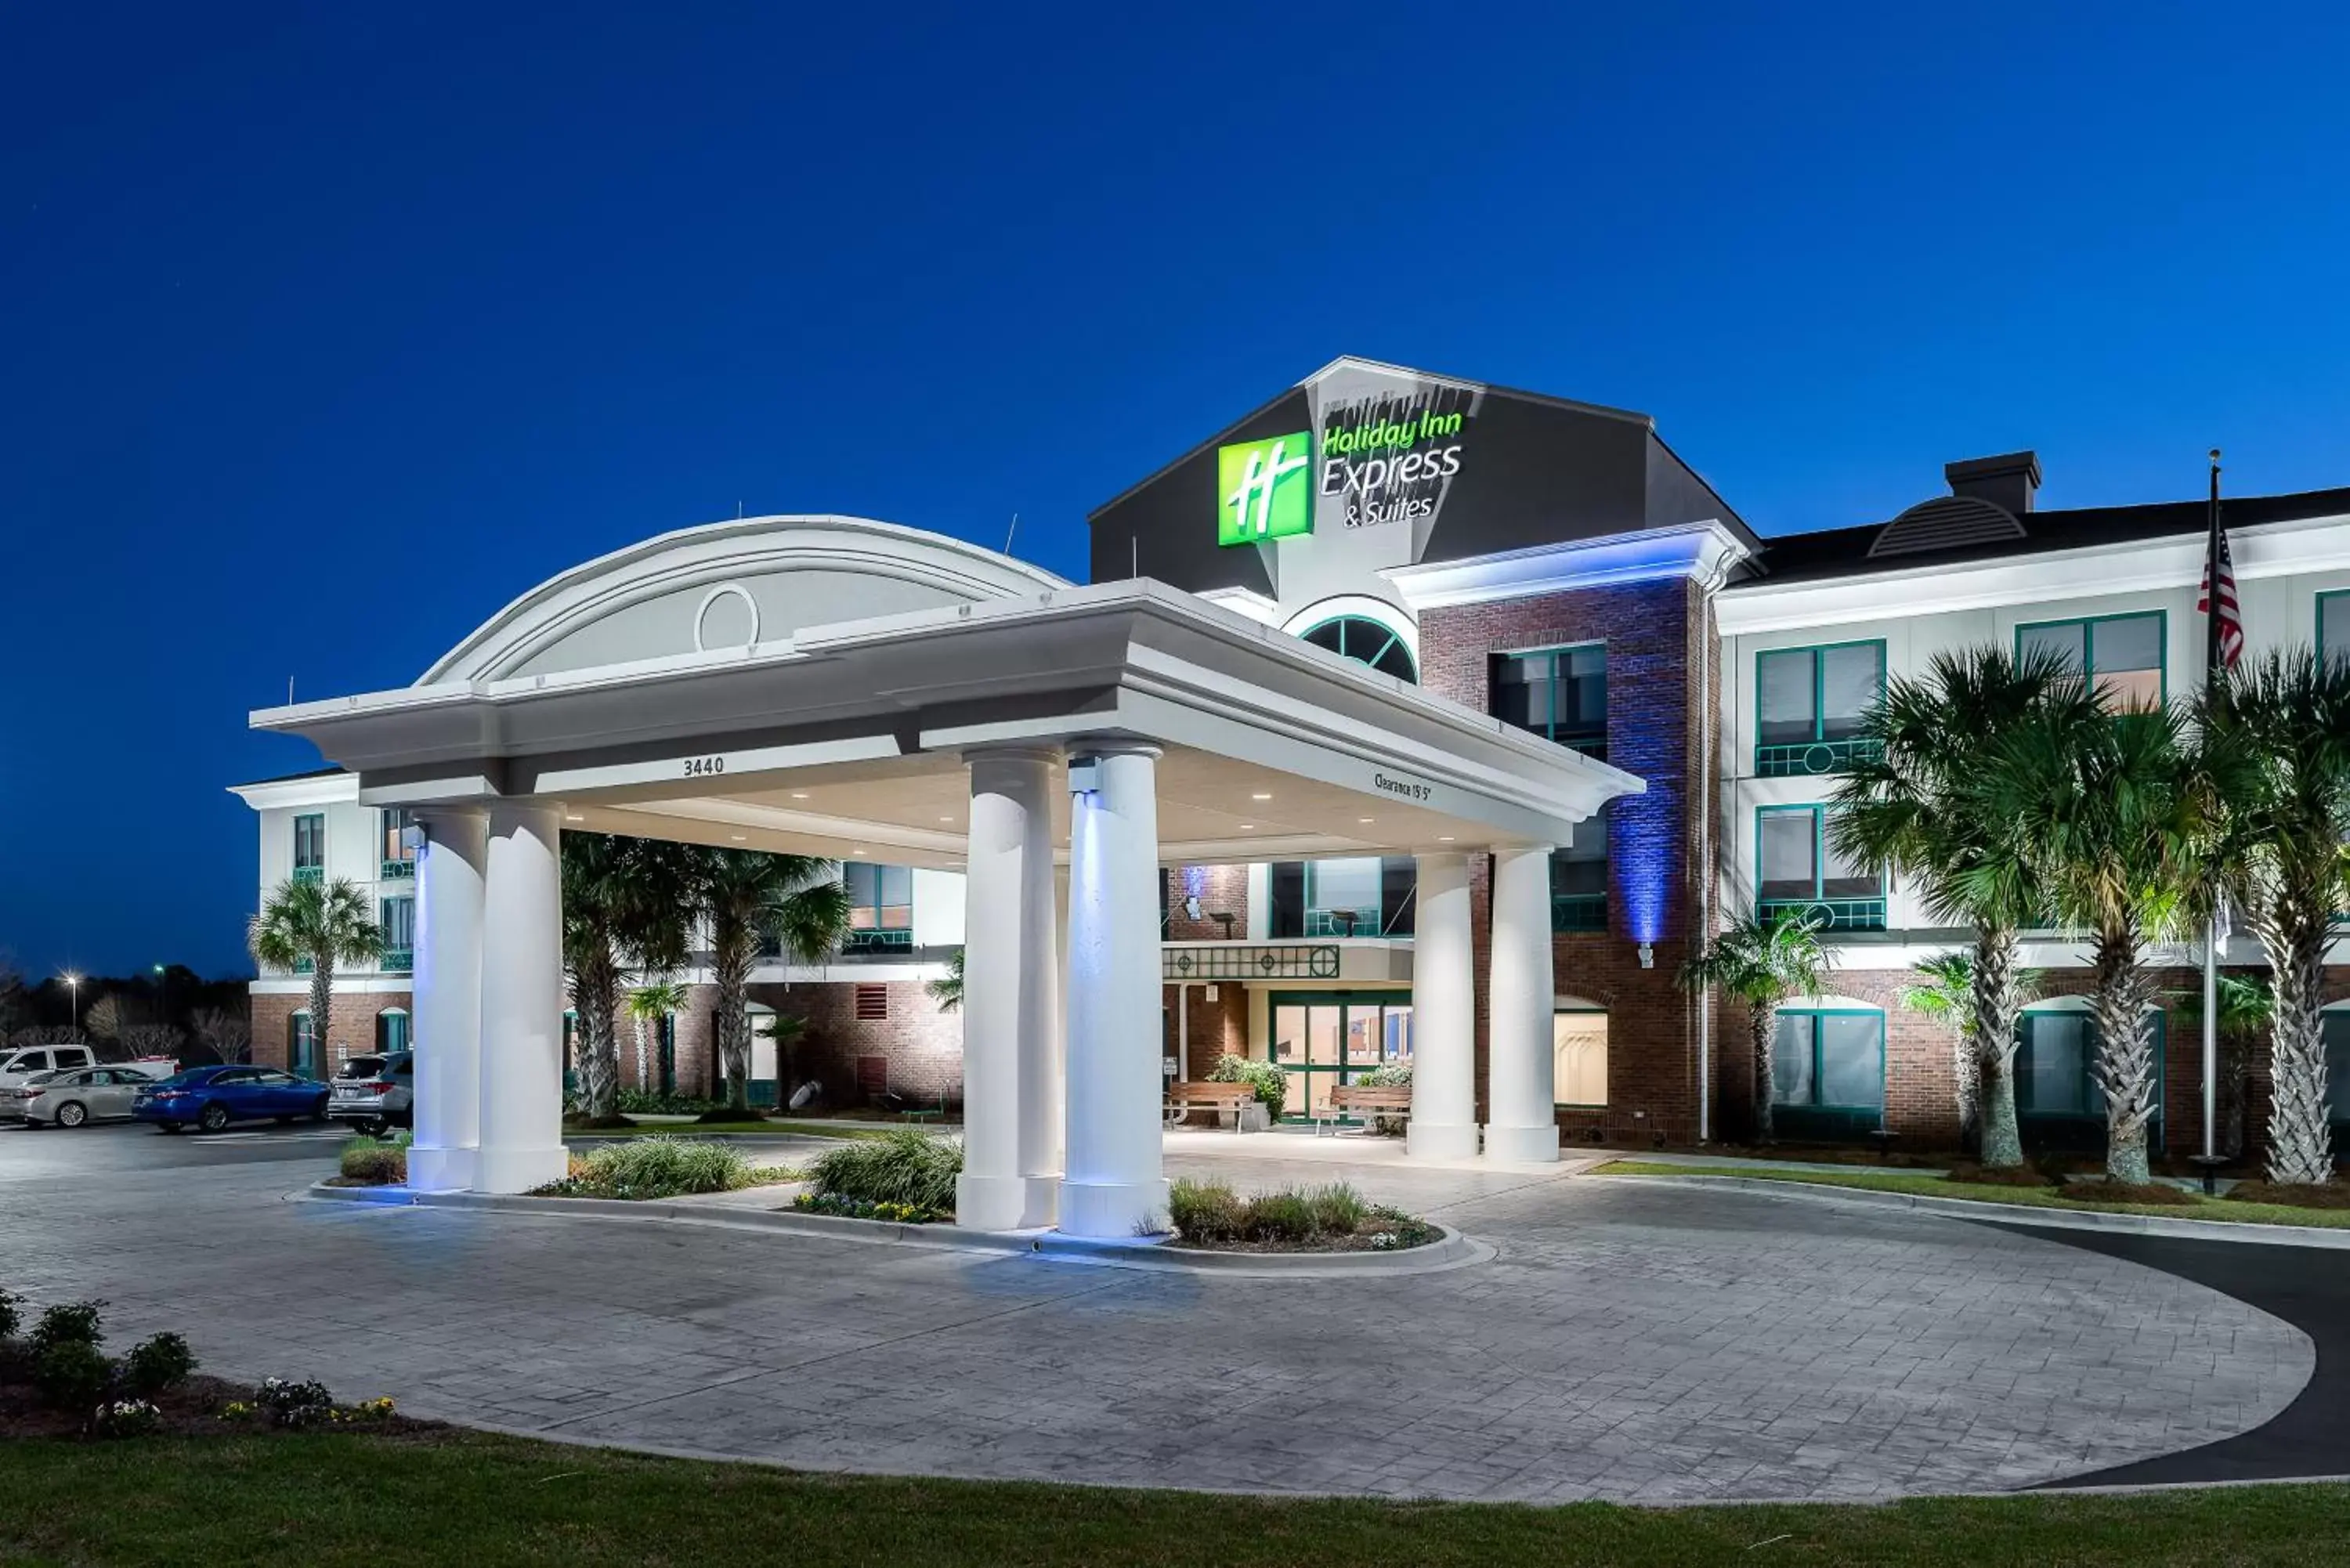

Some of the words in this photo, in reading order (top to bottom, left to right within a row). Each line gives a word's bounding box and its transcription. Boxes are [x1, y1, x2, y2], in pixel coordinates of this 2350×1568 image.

[1321, 417, 1416, 454] Holiday
[1420, 410, 1463, 439] Inn
[1319, 445, 1462, 499] Express
[1343, 505, 1361, 529] &
[1366, 497, 1433, 526] Suites
[684, 757, 724, 776] 3440
